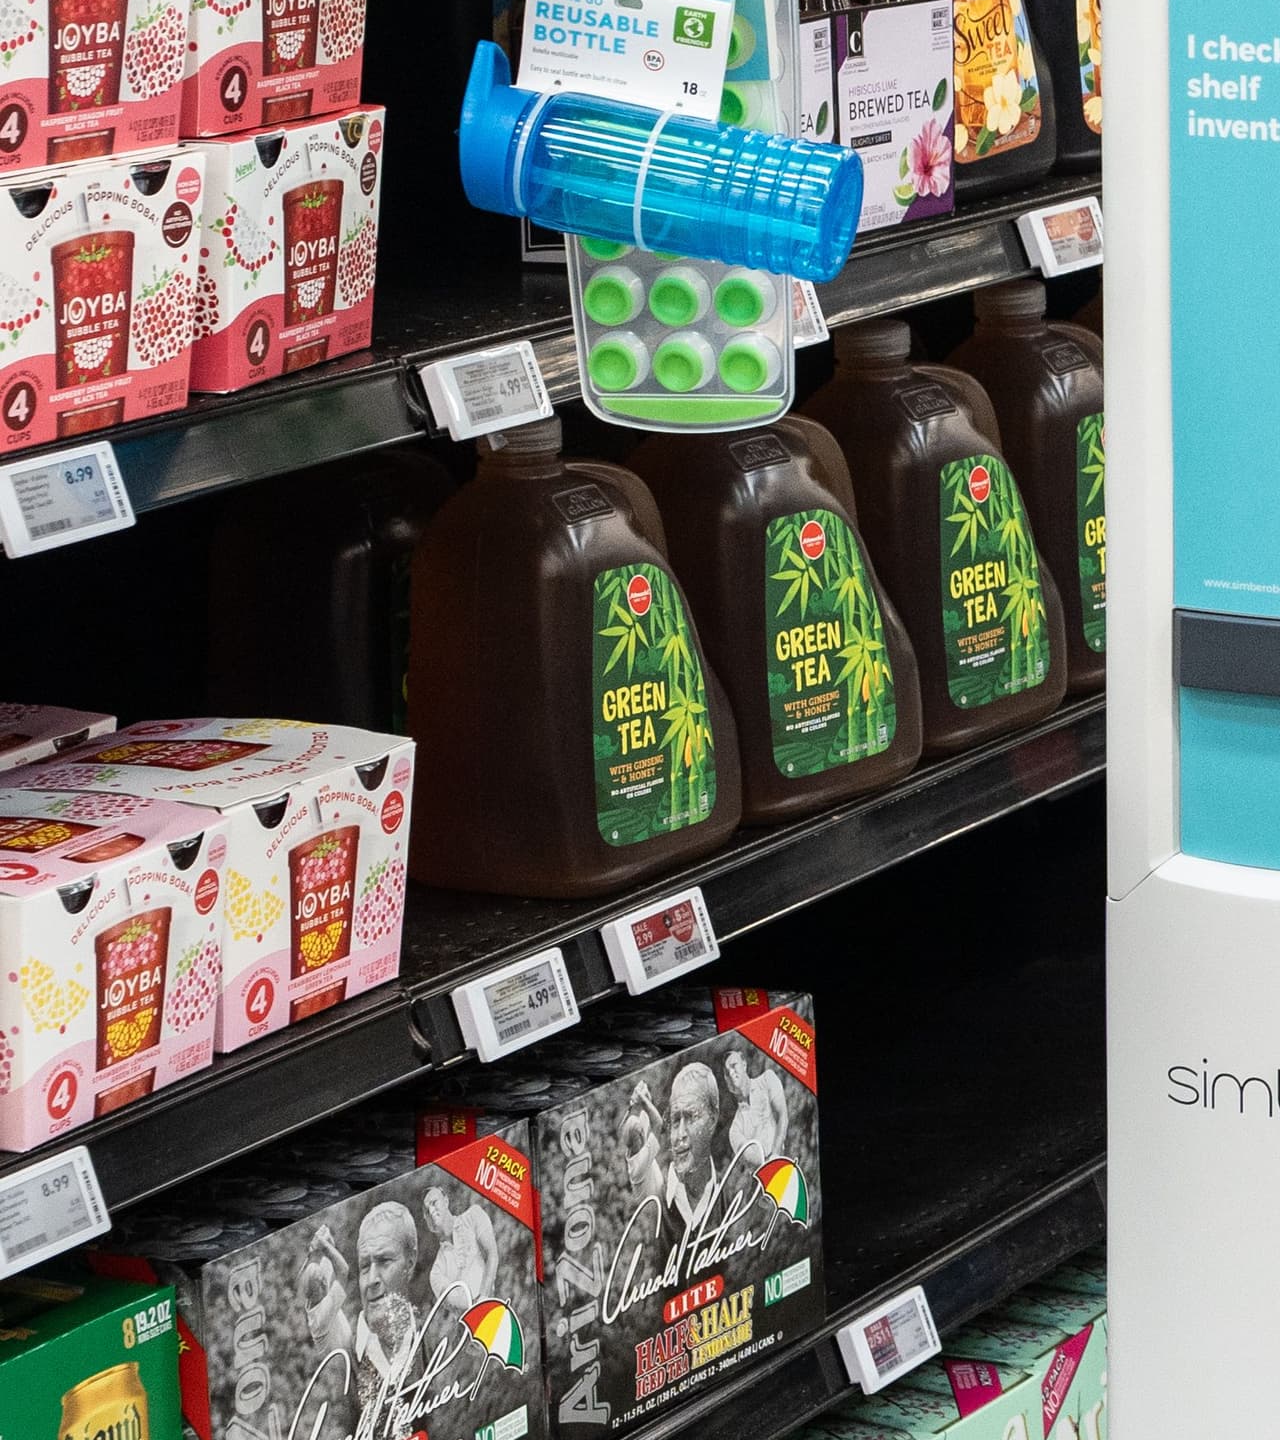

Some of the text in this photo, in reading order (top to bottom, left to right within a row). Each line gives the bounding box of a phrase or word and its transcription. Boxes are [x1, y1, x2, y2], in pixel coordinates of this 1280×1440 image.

[271, 17, 295, 28] BUBBLE
[536, 1, 659, 38] REUSABLE
[53, 21, 120, 51] JOYBA
[533, 24, 626, 54] BOTTLE
[1188, 35, 1196, 59] I
[60, 50, 93, 64] BUBBLE
[682, 82, 698, 95] 18
[849, 79, 897, 97] HIBISCUS LIME
[1187, 74, 1261, 102] shelf
[849, 89, 931, 120] BREWED TEA
[852, 135, 874, 147] SLIGHTLY
[234, 155, 257, 179] New!
[288, 236, 336, 267] JOYBA
[59, 292, 127, 325] JOYBA
[250, 327, 264, 356] 4
[248, 366, 265, 379] CUPS
[8, 388, 30, 419] 4
[7, 430, 31, 444] CUPS
[65, 466, 94, 484] 8.99
[950, 561, 1006, 599] GREEN
[963, 596, 998, 628] TEA
[775, 621, 841, 662] GREEN
[791, 654, 831, 692] TEA
[602, 681, 665, 722] GREEN
[808, 690, 840, 706] GINSENG
[617, 715, 656, 755] TEA
[609, 764, 633, 777] WITH
[629, 768, 655, 781] HONEY
[320, 792, 356, 806] POPPING
[266, 809, 308, 858] DELICIOUS
[295, 880, 351, 921] JOYBA
[300, 916, 328, 931] BUBBLE
[635, 931, 653, 946] 2.99
[101, 966, 162, 1010] JOYBA
[250, 985, 268, 1012] 4
[528, 989, 549, 1011] 4.99
[248, 1023, 269, 1037] CUPS
[778, 1016, 790, 1030] 12
[770, 1029, 787, 1058] NO
[52, 1077, 70, 1109] 4
[475, 1160, 496, 1190] NO
[486, 1146, 526, 1181] 12 PACK
[42, 1174, 70, 1199] 8.99
[669, 1280, 718, 1319] LITE
[134, 1308, 156, 1335] 19.2
[635, 1318, 688, 1378] HALF
[636, 1319, 752, 1400] ICED LEMONADE
